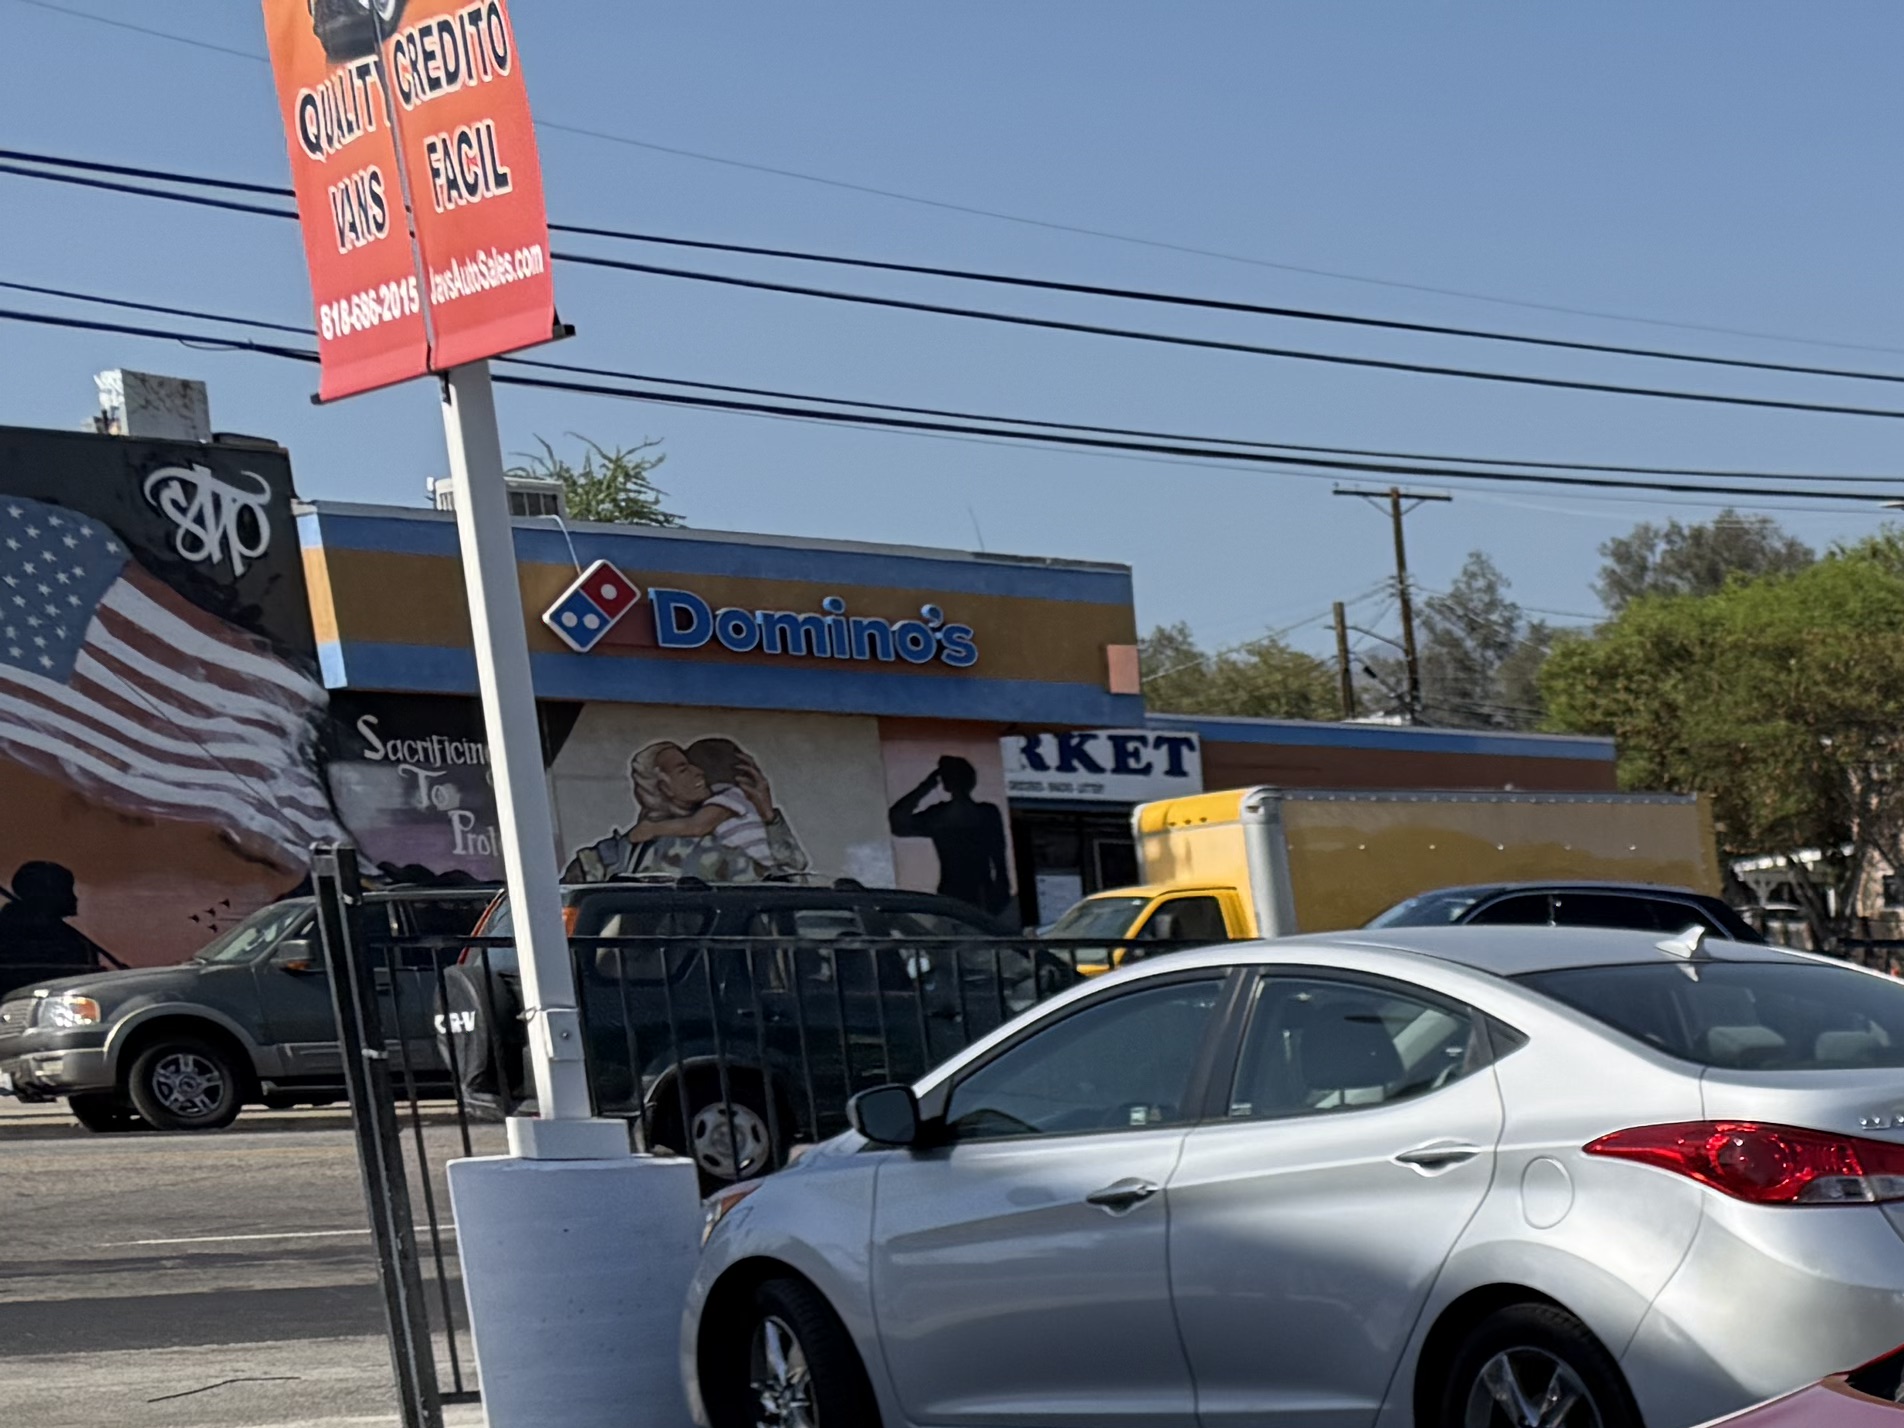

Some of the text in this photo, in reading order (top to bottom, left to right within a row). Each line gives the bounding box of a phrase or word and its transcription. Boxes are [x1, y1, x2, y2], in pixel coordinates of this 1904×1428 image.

[393, 1, 512, 110] CREDITO
[296, 58, 391, 162] QUALIT
[329, 166, 390, 253] VANS
[425, 120, 512, 212] FACIL
[320, 276, 419, 340] 818-686-2015
[647, 587, 978, 667] Domino's
